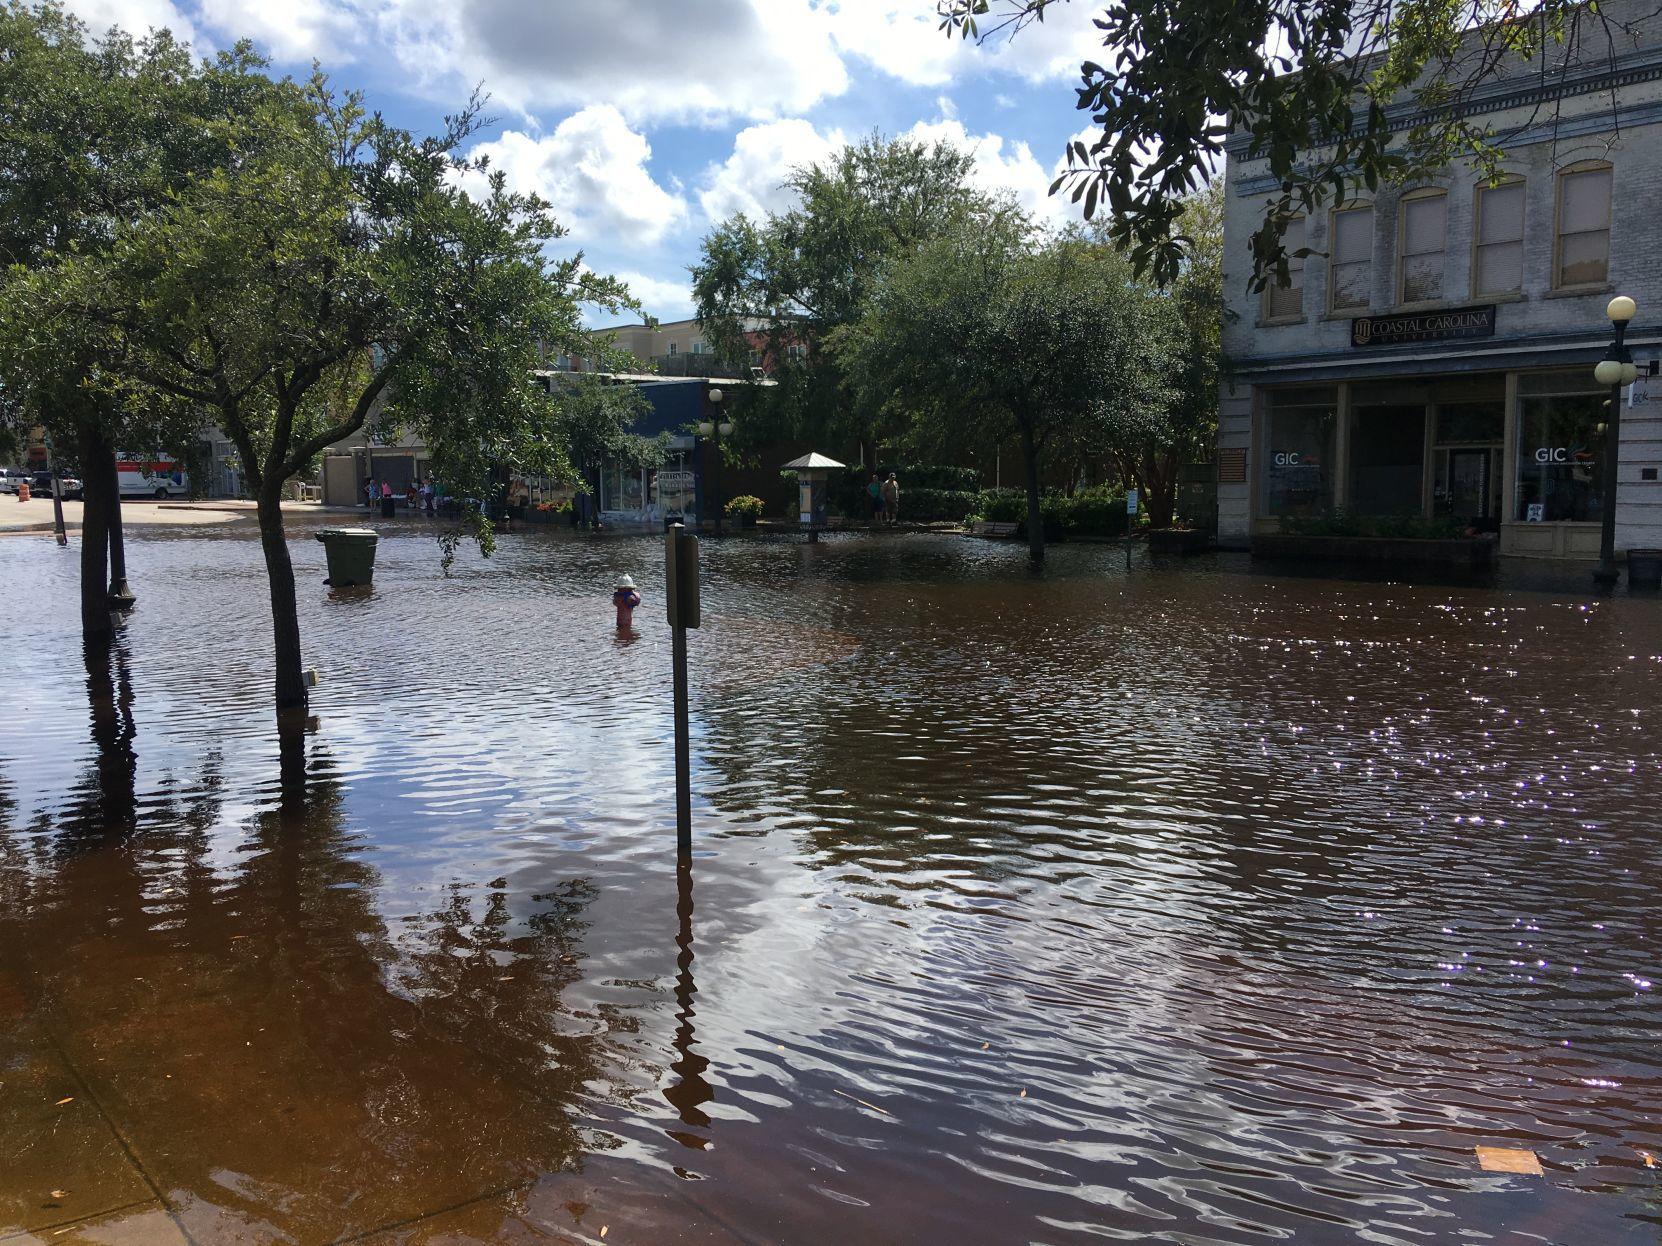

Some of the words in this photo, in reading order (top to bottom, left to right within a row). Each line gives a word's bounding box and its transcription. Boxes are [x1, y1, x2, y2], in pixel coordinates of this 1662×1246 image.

[1372, 319, 1422, 335] COASTAL
[1426, 312, 1489, 330] CAROLINA
[1275, 452, 1299, 465] GIC
[1535, 447, 1566, 462] GIC
